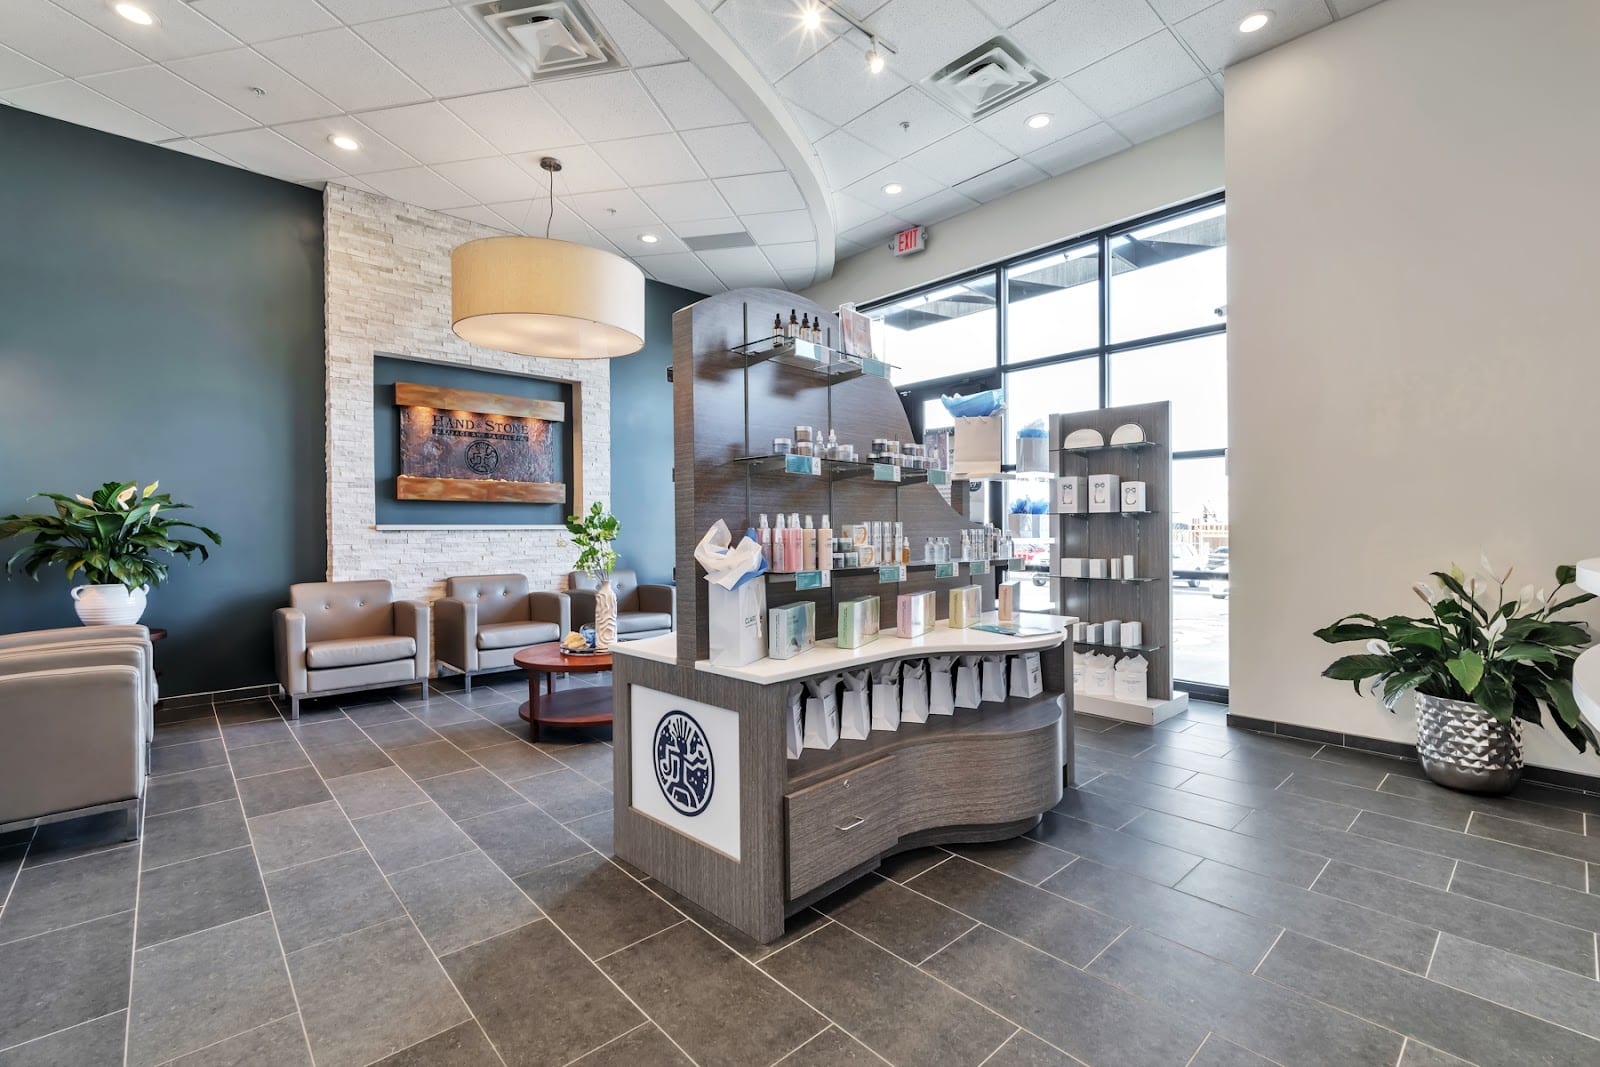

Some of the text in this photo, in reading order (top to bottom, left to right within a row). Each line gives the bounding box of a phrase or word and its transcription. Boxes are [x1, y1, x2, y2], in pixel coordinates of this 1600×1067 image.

[898, 227, 919, 252] EXIT
[432, 414, 475, 430] HAND
[485, 420, 529, 435] STONE
